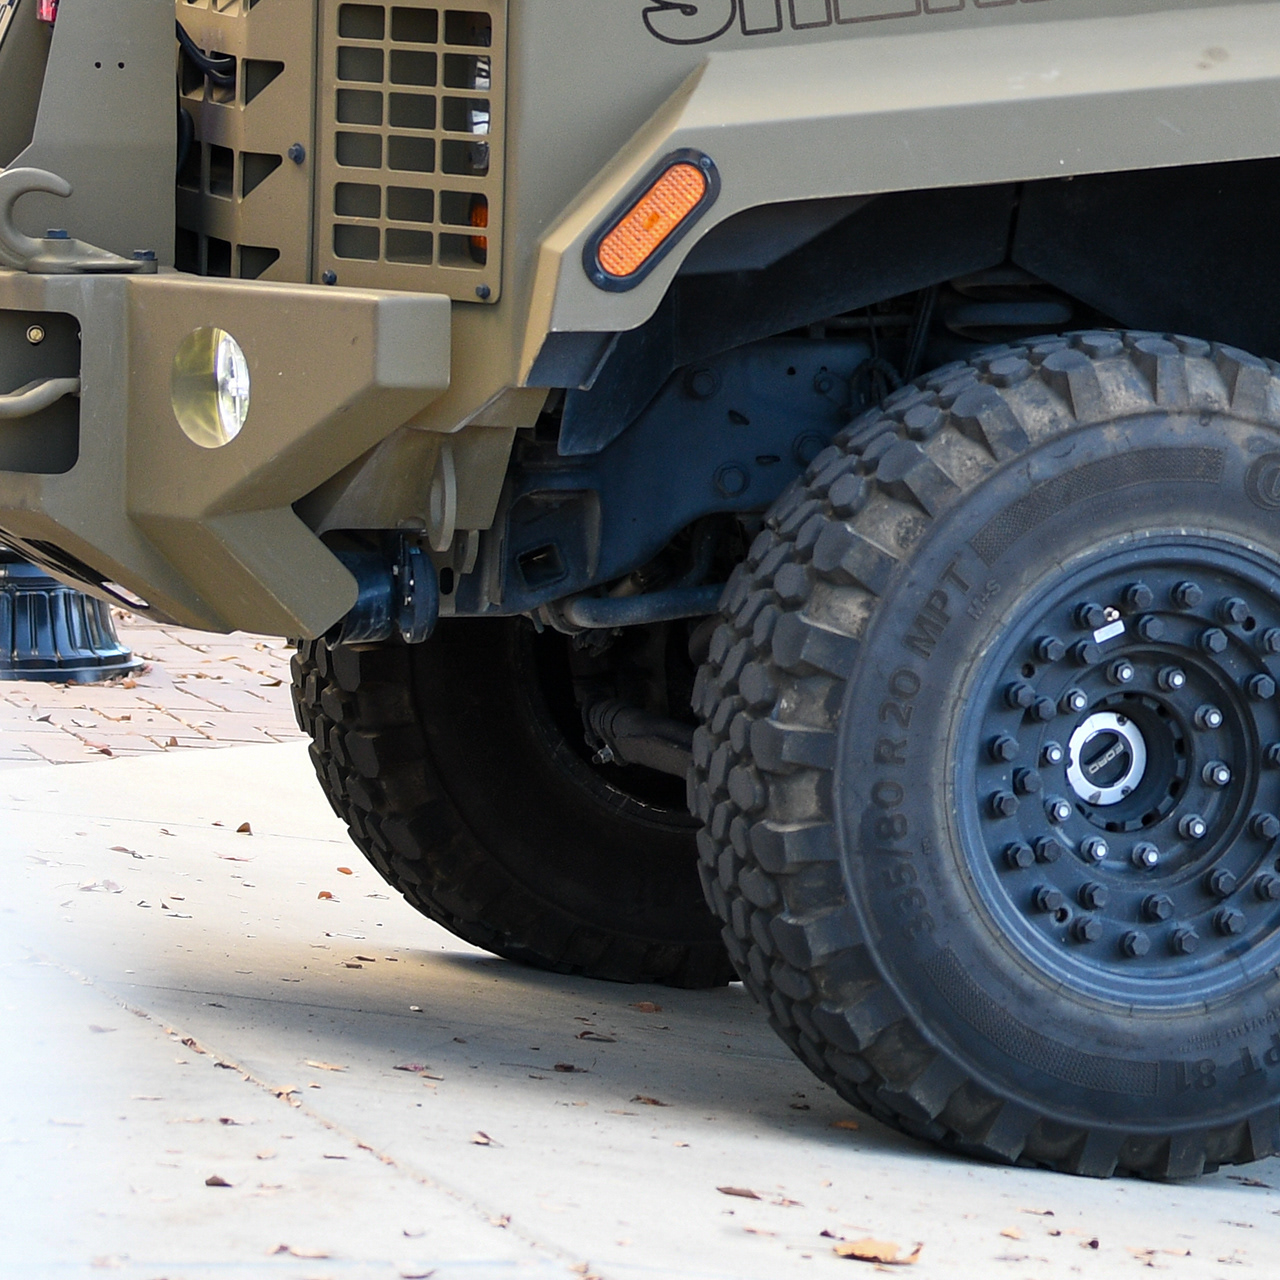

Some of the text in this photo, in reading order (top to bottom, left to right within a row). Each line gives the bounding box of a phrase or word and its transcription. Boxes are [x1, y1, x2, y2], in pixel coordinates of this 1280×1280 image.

[901, 561, 970, 660] MPT
[878, 662, 922, 728] 20
[874, 737, 906, 765] R
[873, 781, 938, 944] 335/80
[1175, 1058, 1218, 1093] 81
